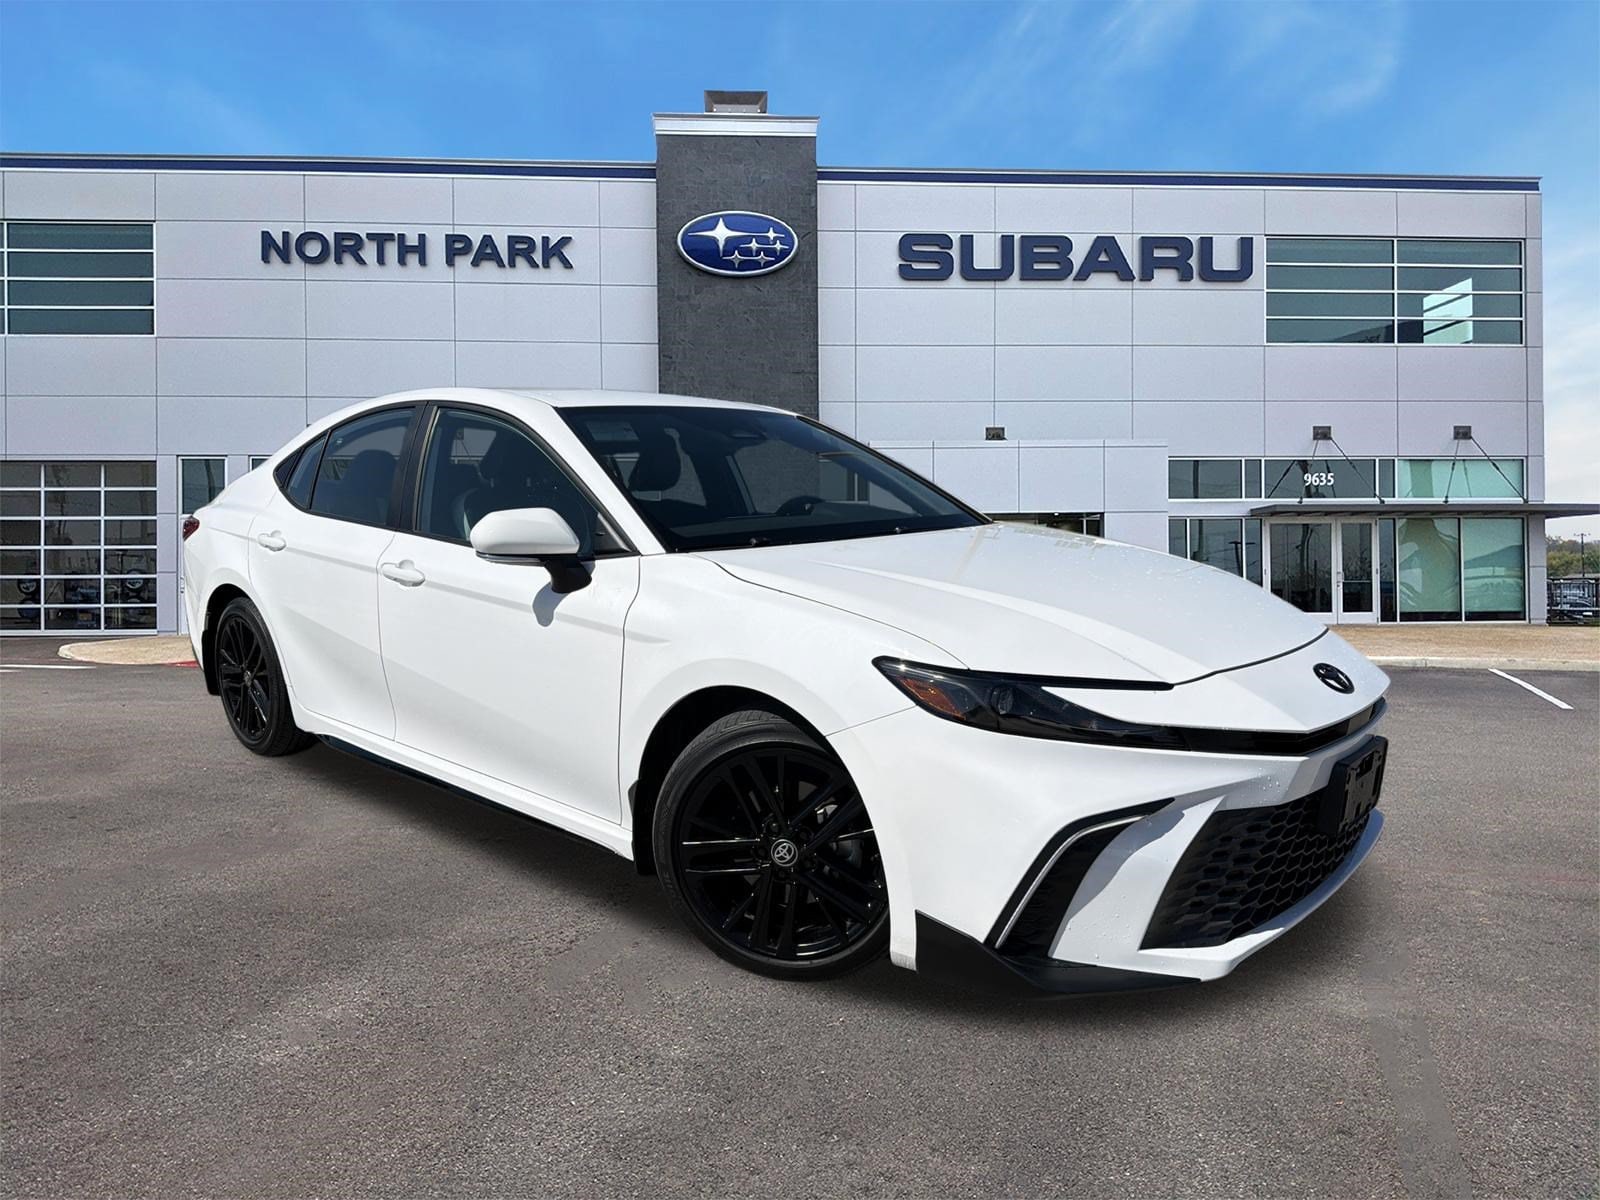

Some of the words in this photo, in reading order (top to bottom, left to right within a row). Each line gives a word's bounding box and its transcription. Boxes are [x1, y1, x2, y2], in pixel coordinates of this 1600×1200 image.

[260, 230, 427, 268] NORTH
[445, 233, 574, 270] PARK
[898, 233, 1254, 284] SUBARU
[1303, 472, 1335, 486] 9635
